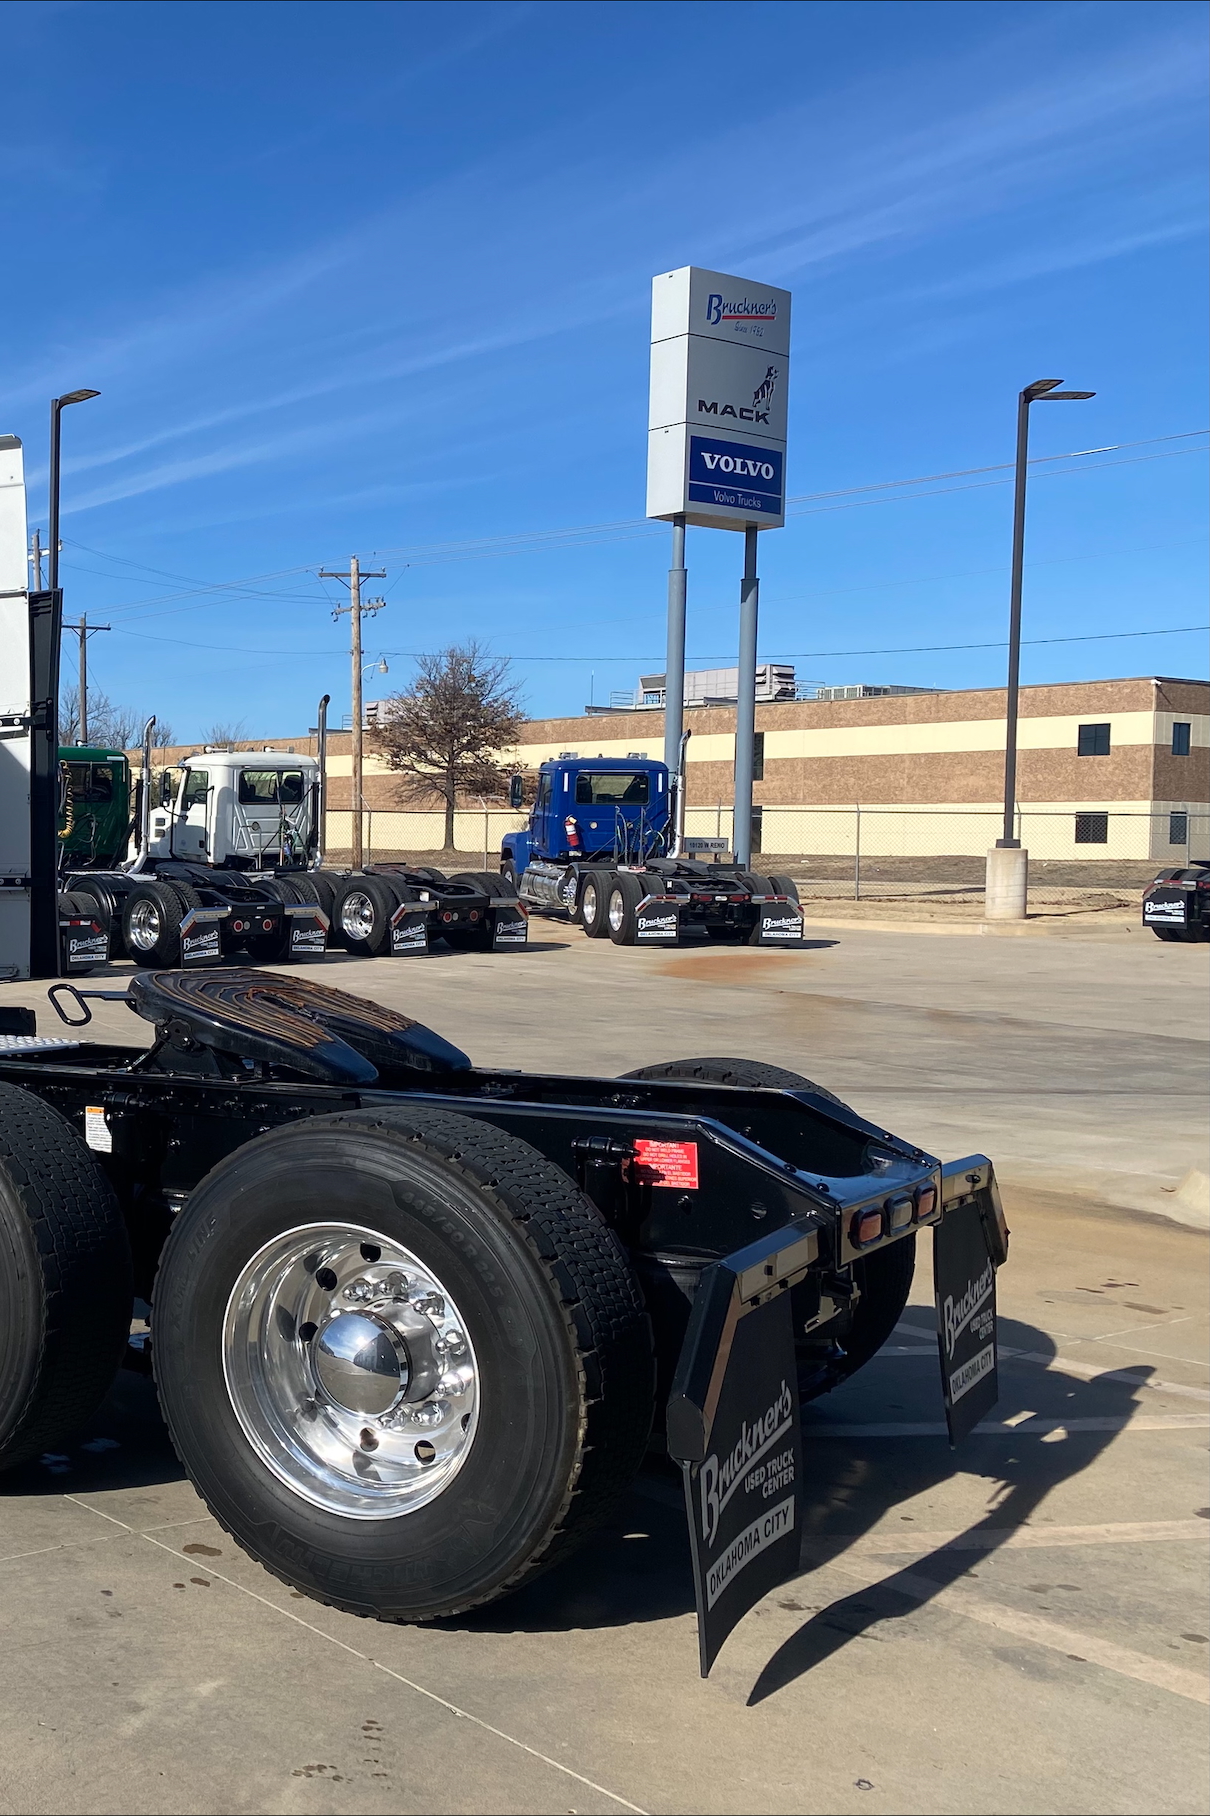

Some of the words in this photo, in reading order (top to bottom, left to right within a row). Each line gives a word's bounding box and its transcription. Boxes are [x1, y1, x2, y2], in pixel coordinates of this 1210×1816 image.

[706, 294, 777, 326] Bruckner's
[698, 399, 770, 425] MACK
[700, 452, 774, 480] VOLVO
[713, 490, 736, 505] Volvo
[737, 493, 762, 509] Trucks
[461, 1243, 478, 1260] R
[472, 1259, 505, 1298] 22.5
[944, 1256, 993, 1360] Bruckner's
[952, 1361, 980, 1395] OKLAHOMA
[980, 1348, 992, 1371] CITY
[700, 1379, 792, 1548] Bruckner's
[744, 1466, 766, 1493] USED
[766, 1447, 794, 1478] TRUCK
[762, 1465, 795, 1498] CENTER
[274, 1537, 435, 1588] MICHELIN
[710, 1527, 761, 1596] OKLAHOMA
[764, 1505, 790, 1538] CITY
